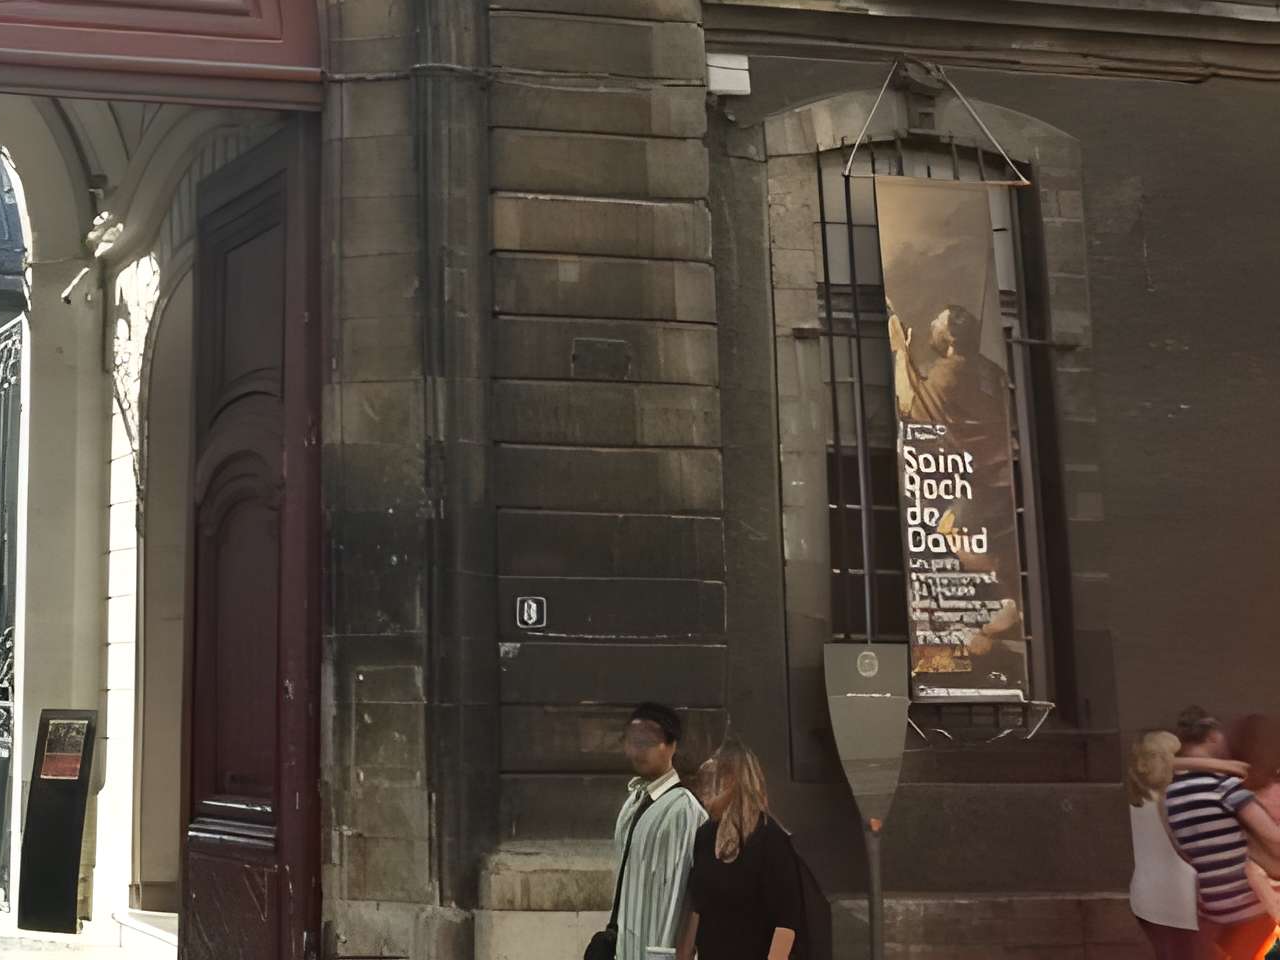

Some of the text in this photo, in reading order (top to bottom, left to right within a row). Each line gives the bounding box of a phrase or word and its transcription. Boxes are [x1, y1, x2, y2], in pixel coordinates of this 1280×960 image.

[903, 445, 974, 473] Saint
[906, 498, 940, 527] de
[907, 526, 988, 553] David
